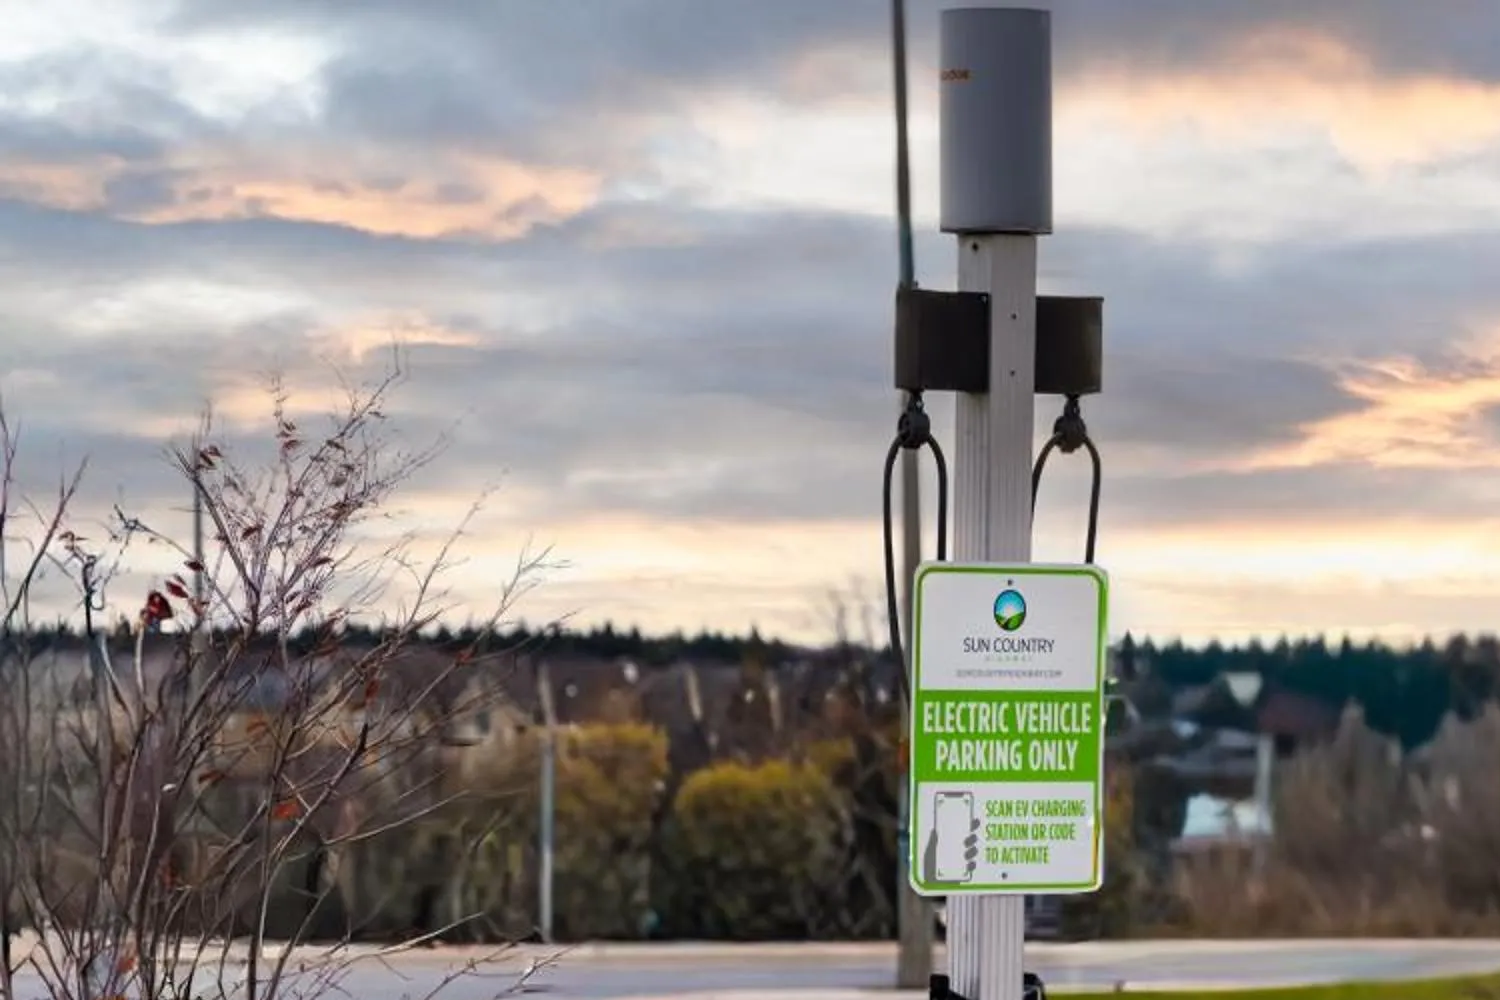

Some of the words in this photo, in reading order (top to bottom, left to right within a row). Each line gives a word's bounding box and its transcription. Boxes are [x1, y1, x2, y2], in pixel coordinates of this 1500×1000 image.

[963, 637, 991, 653] SUN
[993, 637, 1055, 653] COUNTRY
[923, 701, 1009, 733] ELECTRIC
[1014, 701, 1092, 733] VEHICLE
[935, 739, 1023, 771] PARKING
[1028, 739, 1079, 771] ONLY
[985, 799, 1013, 817] SCAN
[1015, 799, 1029, 817] EV
[1031, 799, 1086, 817] CHARGING
[985, 823, 1029, 840] STATION
[1049, 823, 1076, 840] CODE
[985, 847, 999, 865] TO
[1001, 847, 1049, 865] ACTIVATE
